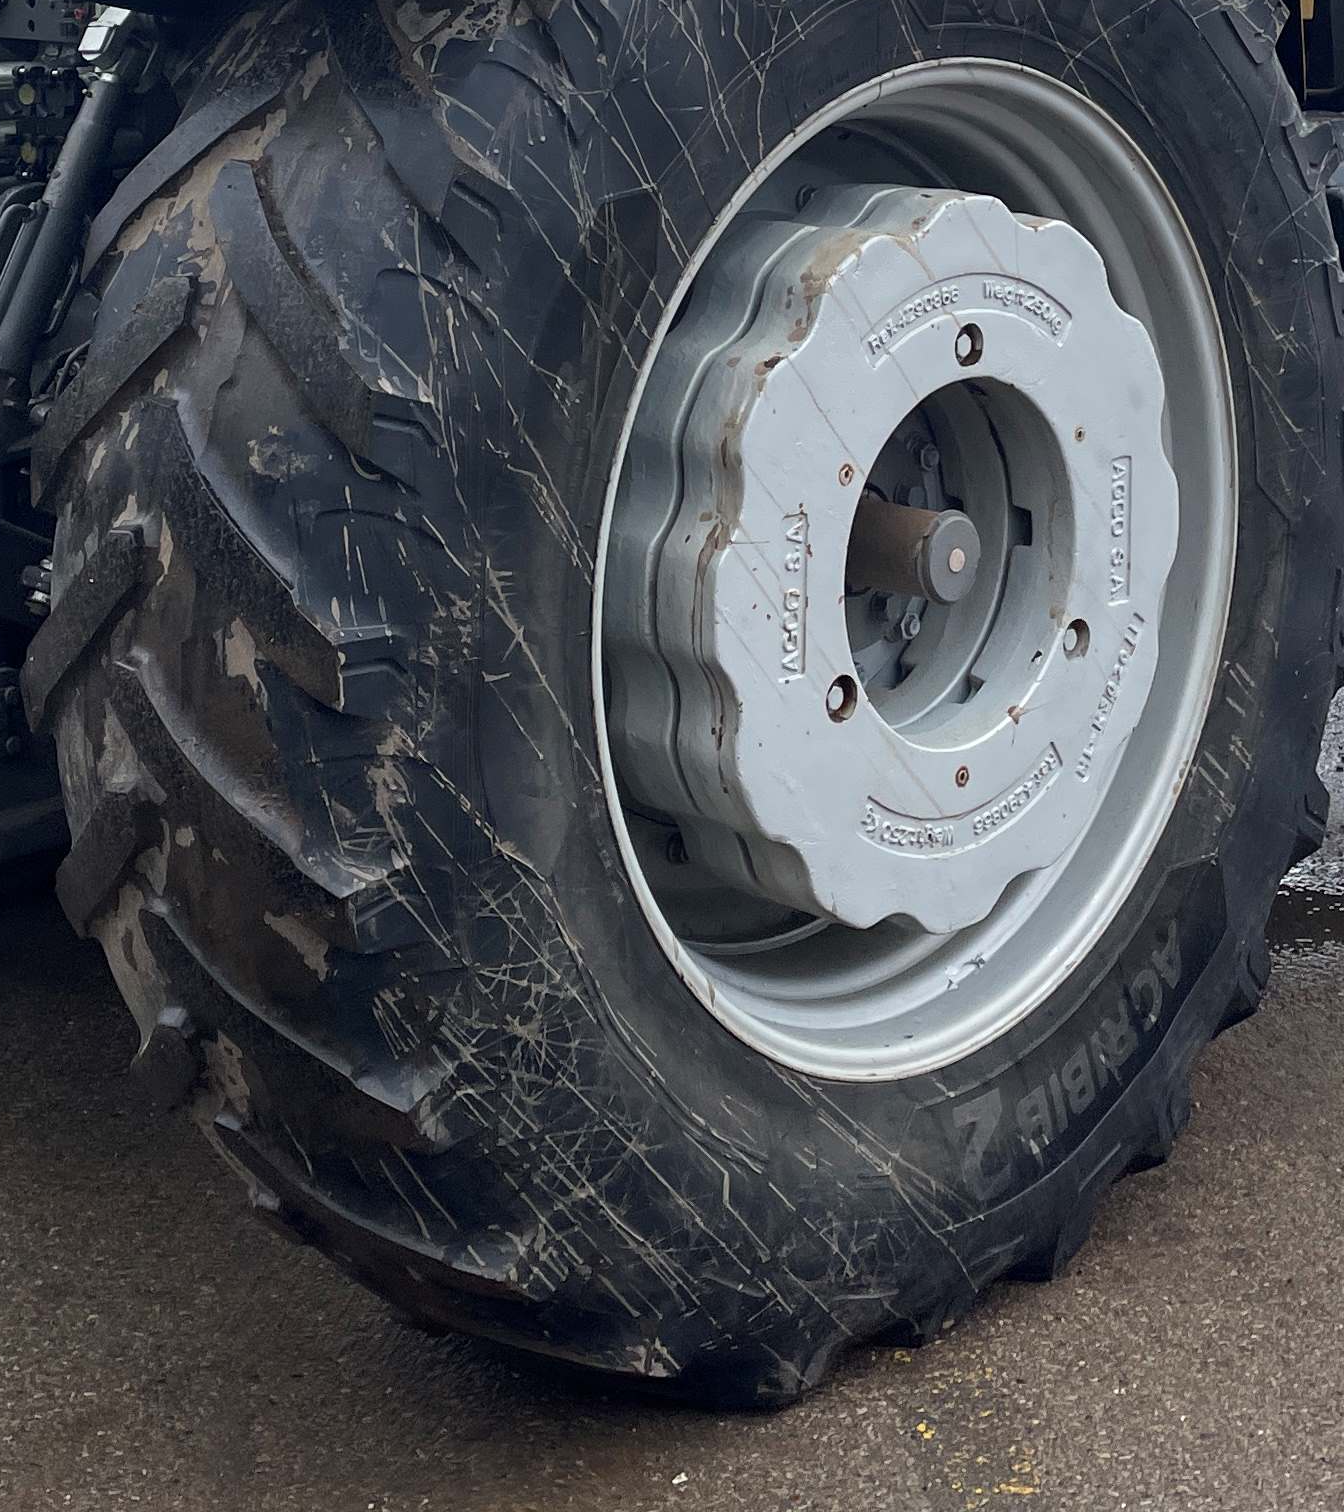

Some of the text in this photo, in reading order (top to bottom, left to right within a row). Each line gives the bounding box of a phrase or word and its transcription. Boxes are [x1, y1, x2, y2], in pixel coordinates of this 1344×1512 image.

[1110, 463, 1127, 539] AGCO
[782, 588, 800, 672] AGCO
[952, 1087, 1011, 1201] 2
